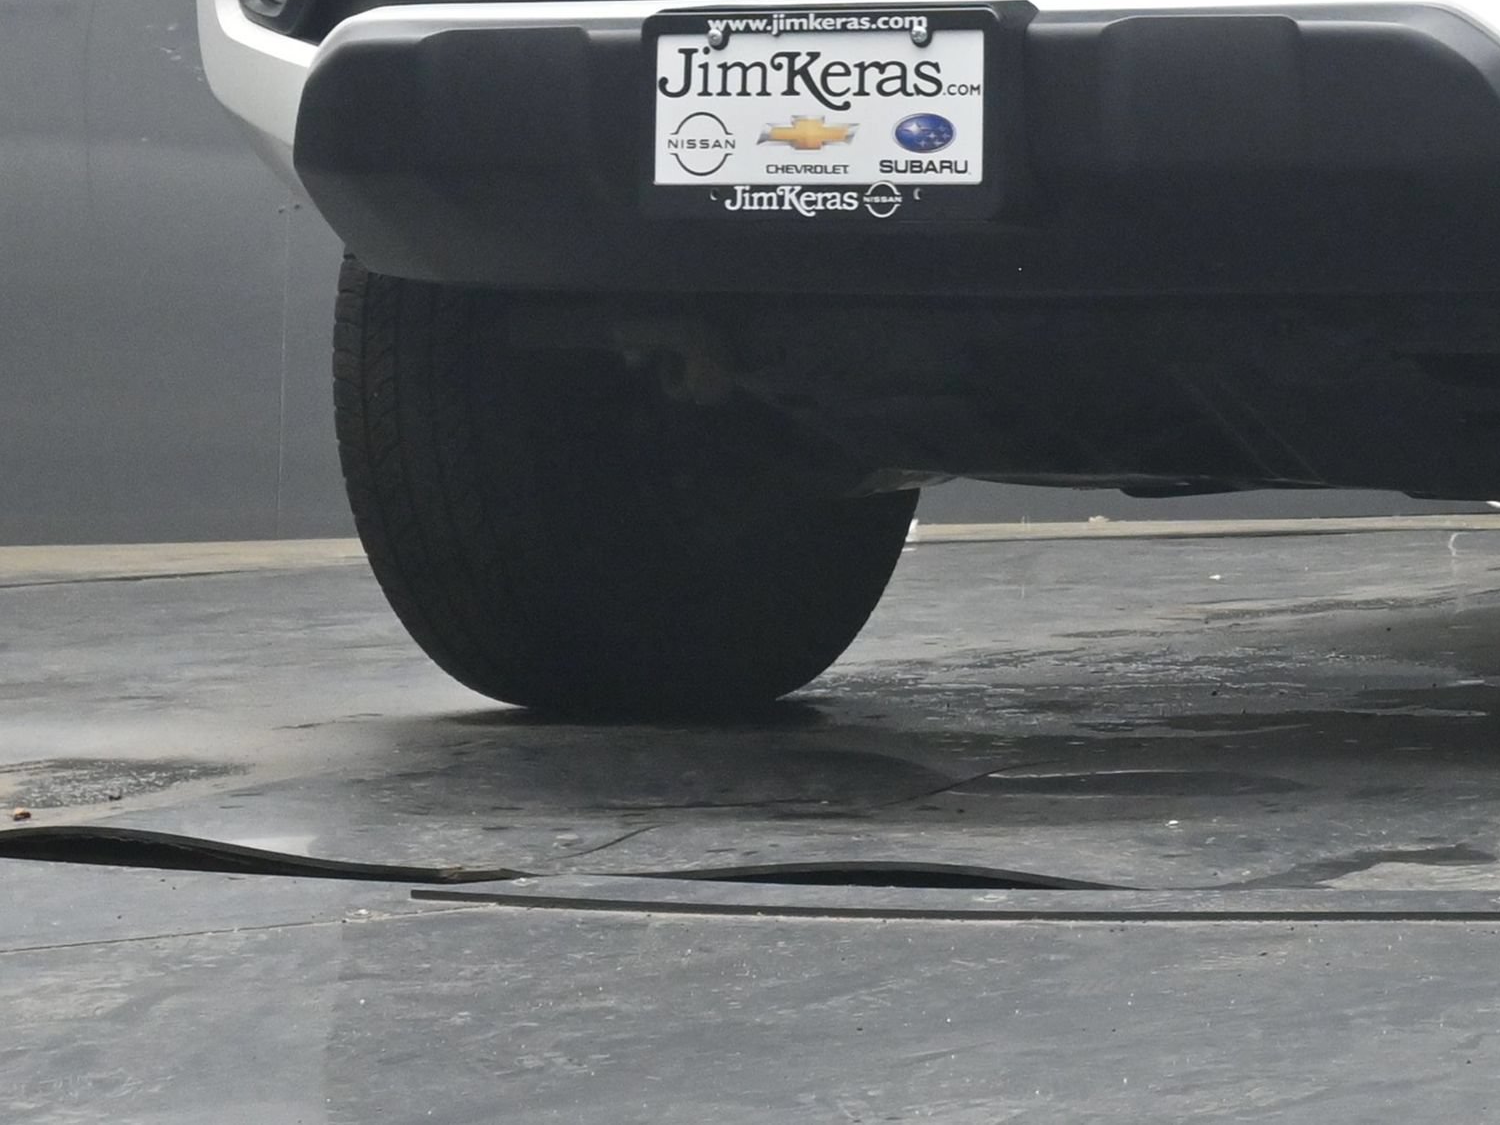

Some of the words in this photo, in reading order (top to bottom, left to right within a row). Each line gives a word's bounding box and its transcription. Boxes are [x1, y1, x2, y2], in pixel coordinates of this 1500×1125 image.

[707, 13, 928, 36] www.jimkeras.com
[667, 138, 737, 150] NISSAN
[765, 163, 851, 175] CHEVROLET
[879, 159, 969, 175] SUBARU
[862, 195, 903, 204] NISSAN
